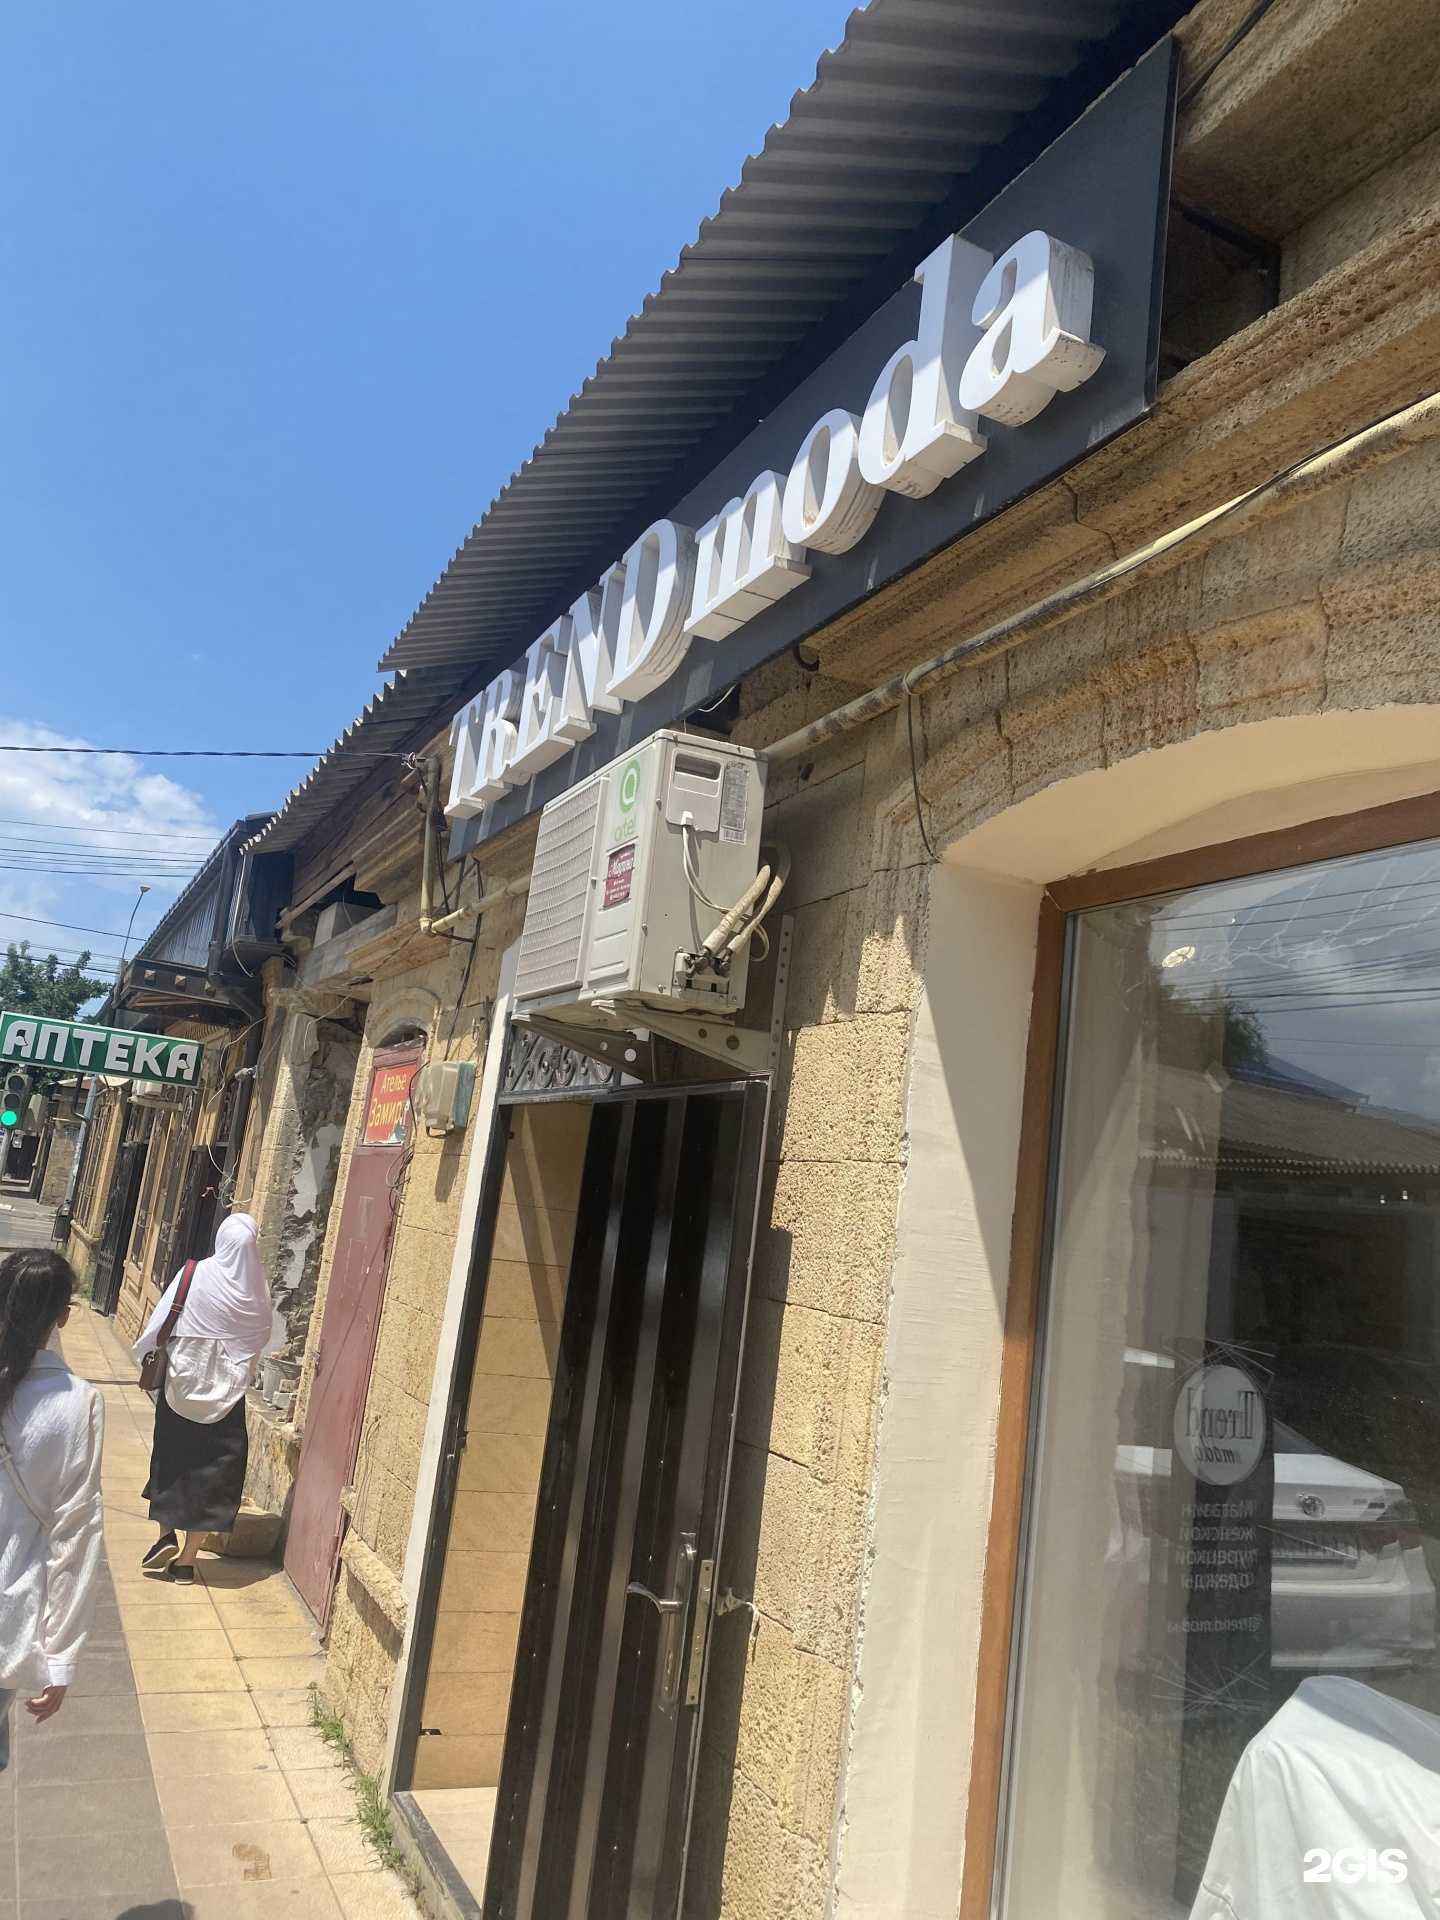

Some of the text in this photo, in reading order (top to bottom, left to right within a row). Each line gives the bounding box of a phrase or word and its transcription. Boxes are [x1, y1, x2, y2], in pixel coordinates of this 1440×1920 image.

[444, 230, 1104, 819] TREND moda
[2, 1020, 199, 1081] АПТЕКА
[382, 1073, 407, 1093] Ателье
